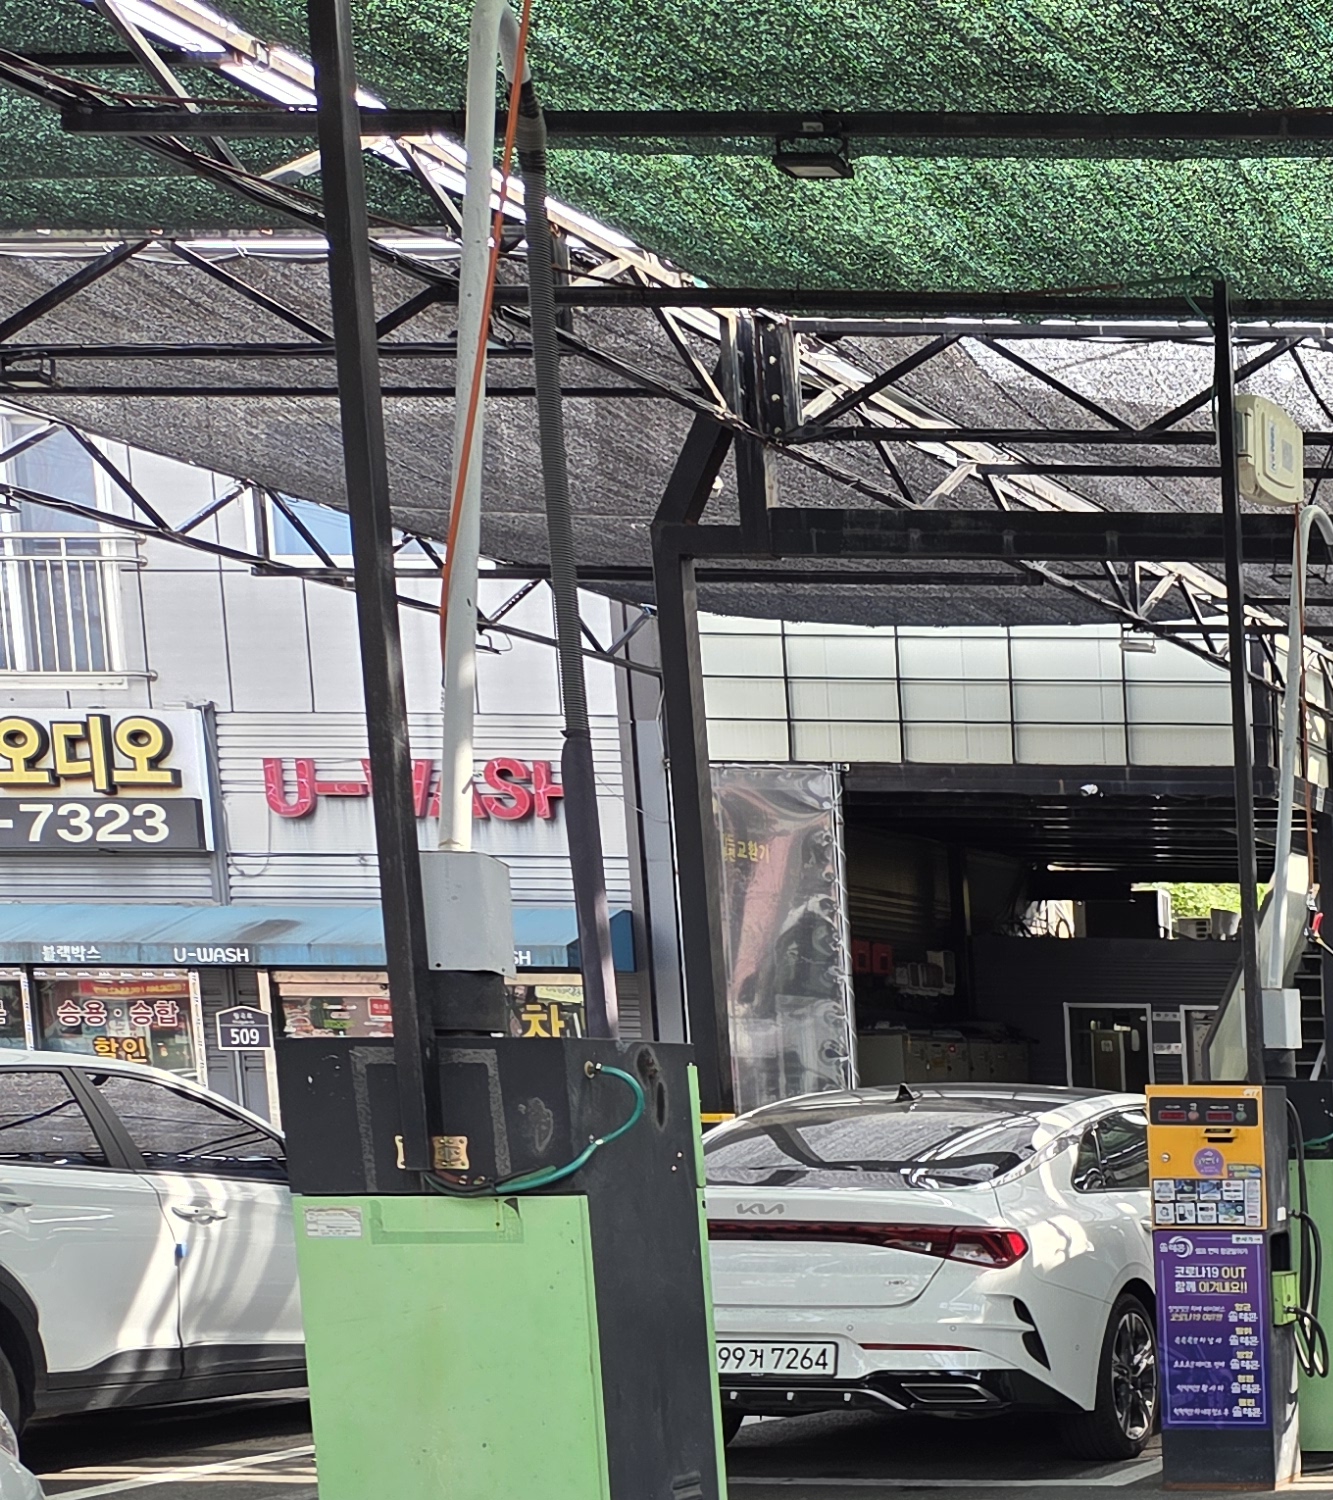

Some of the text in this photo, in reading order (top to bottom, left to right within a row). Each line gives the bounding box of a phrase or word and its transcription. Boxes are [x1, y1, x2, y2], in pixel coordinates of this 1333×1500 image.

[0, 714, 181, 795] 오디오
[41, 945, 102, 962] 블랙박스
[173, 947, 250, 963] U-WASH
[230, 1028, 259, 1045] 509
[1174, 1266, 1247, 1279] 코로나19 OUT
[717, 1347, 828, 1370] 99거 7264
